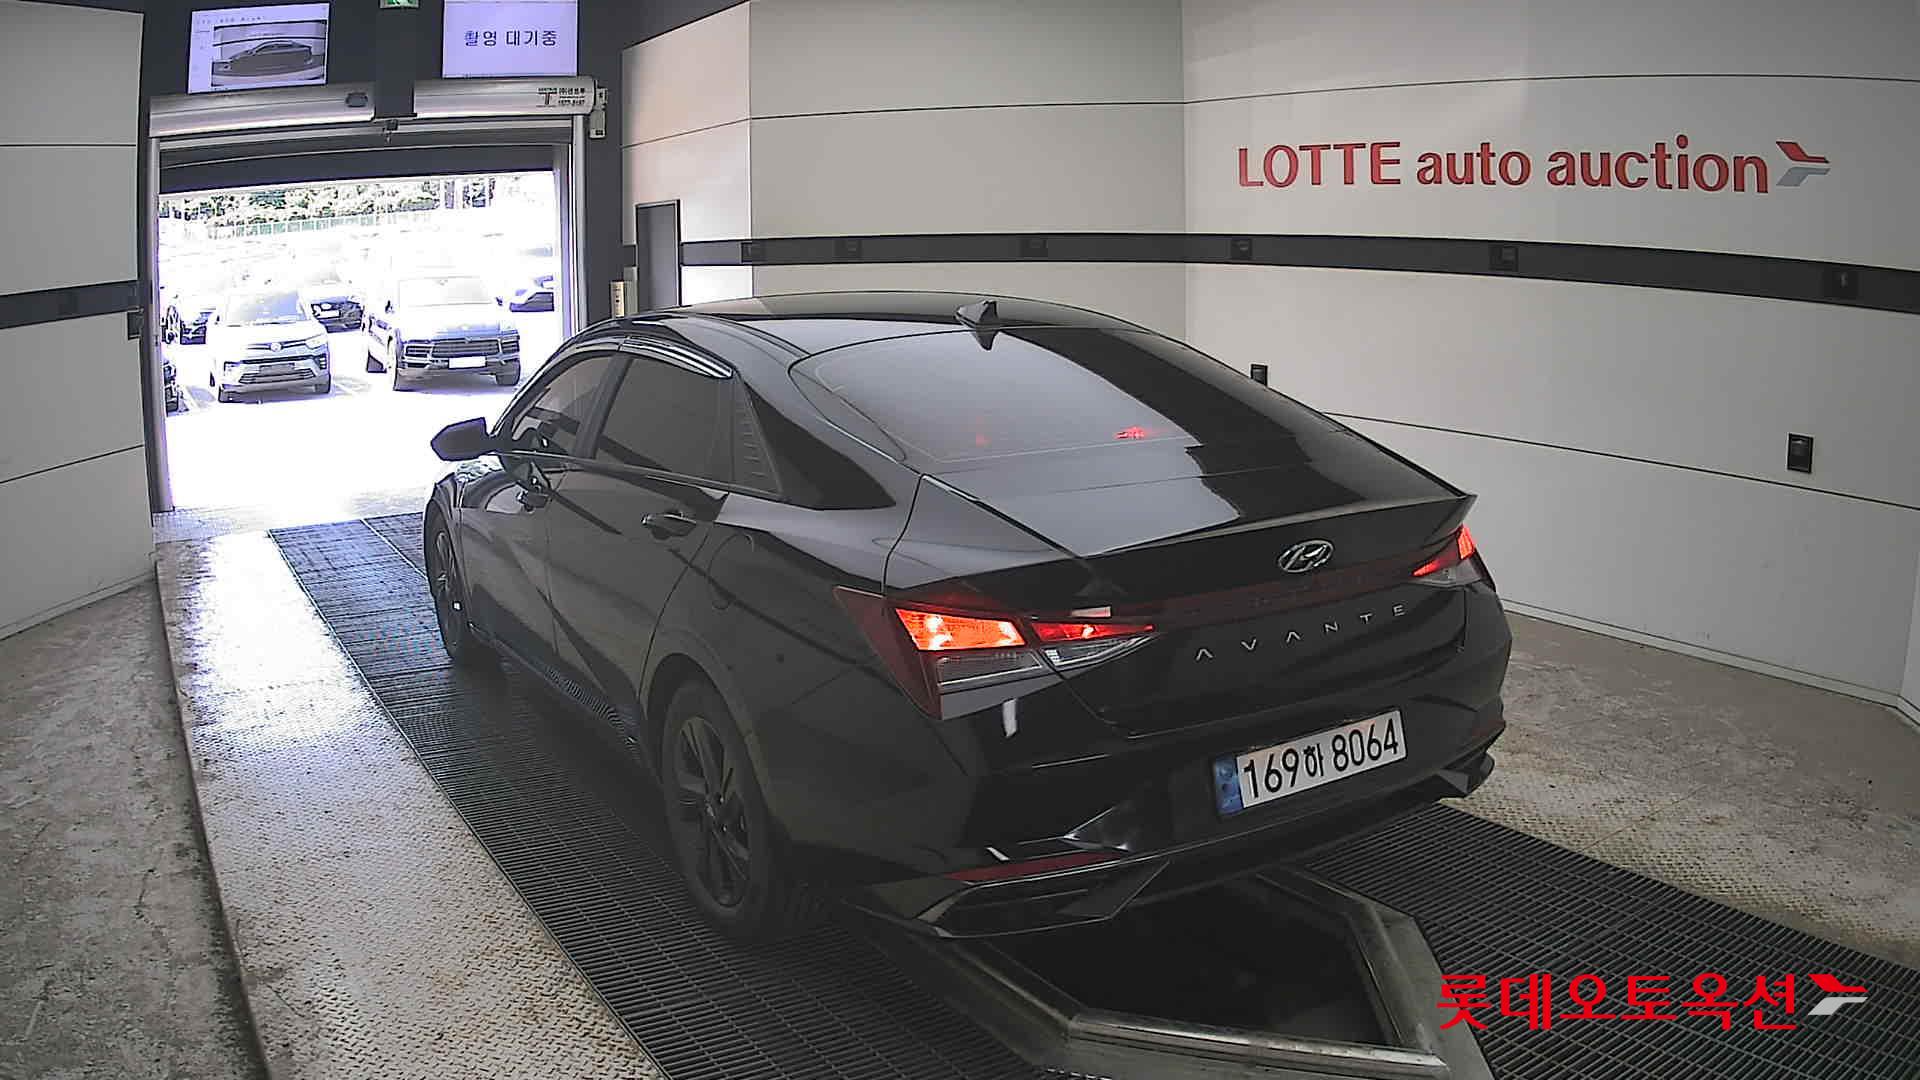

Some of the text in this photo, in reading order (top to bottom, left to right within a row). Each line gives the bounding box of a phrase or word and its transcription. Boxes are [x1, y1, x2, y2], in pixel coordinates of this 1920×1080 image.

[506, 30, 557, 46] 대기중
[1238, 134, 1769, 194] LOTTE auto auction
[1195, 604, 1406, 662] AVANTE
[1244, 718, 1399, 799] 169하 8064
